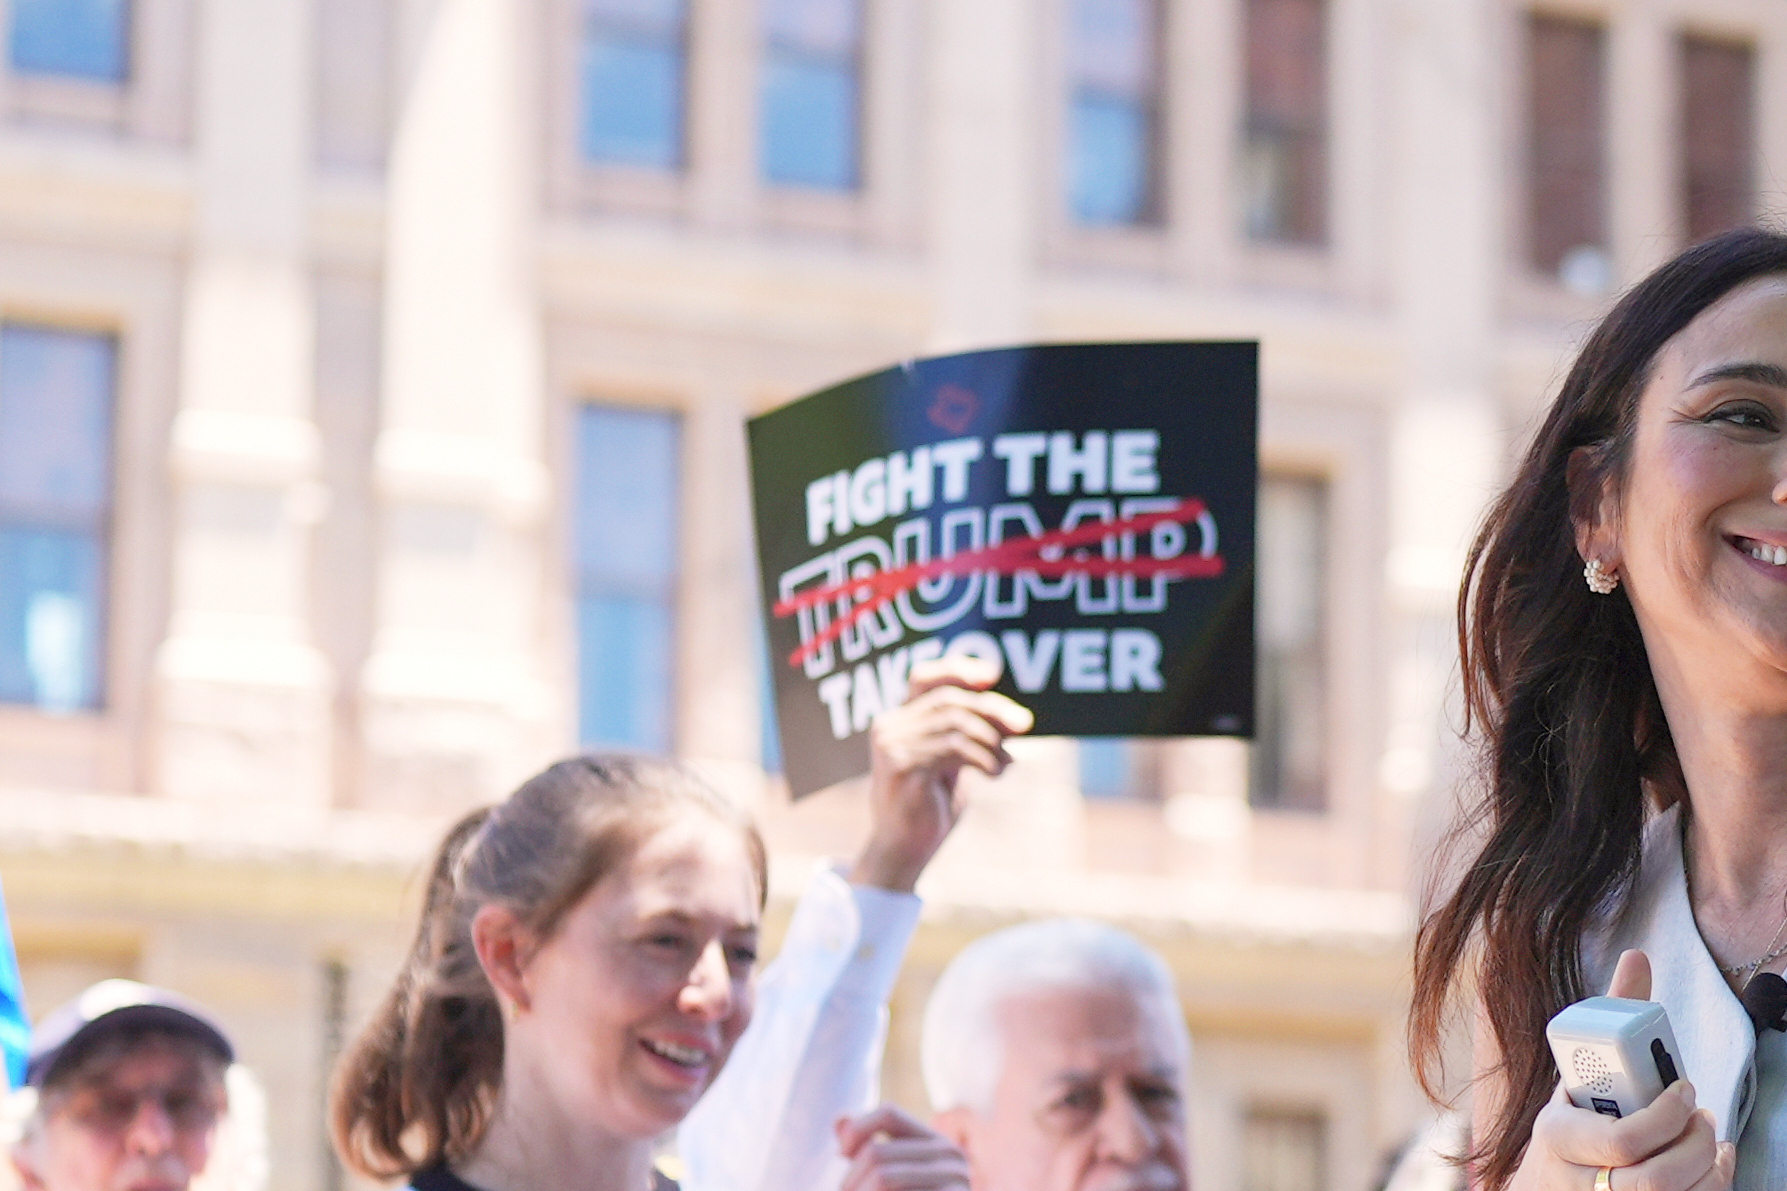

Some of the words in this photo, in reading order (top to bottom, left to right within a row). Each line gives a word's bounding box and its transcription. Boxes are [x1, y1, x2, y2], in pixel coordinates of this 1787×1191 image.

[806, 437, 984, 546] FIGHT
[993, 429, 1161, 497] THE
[778, 497, 1218, 681] TRUMP
